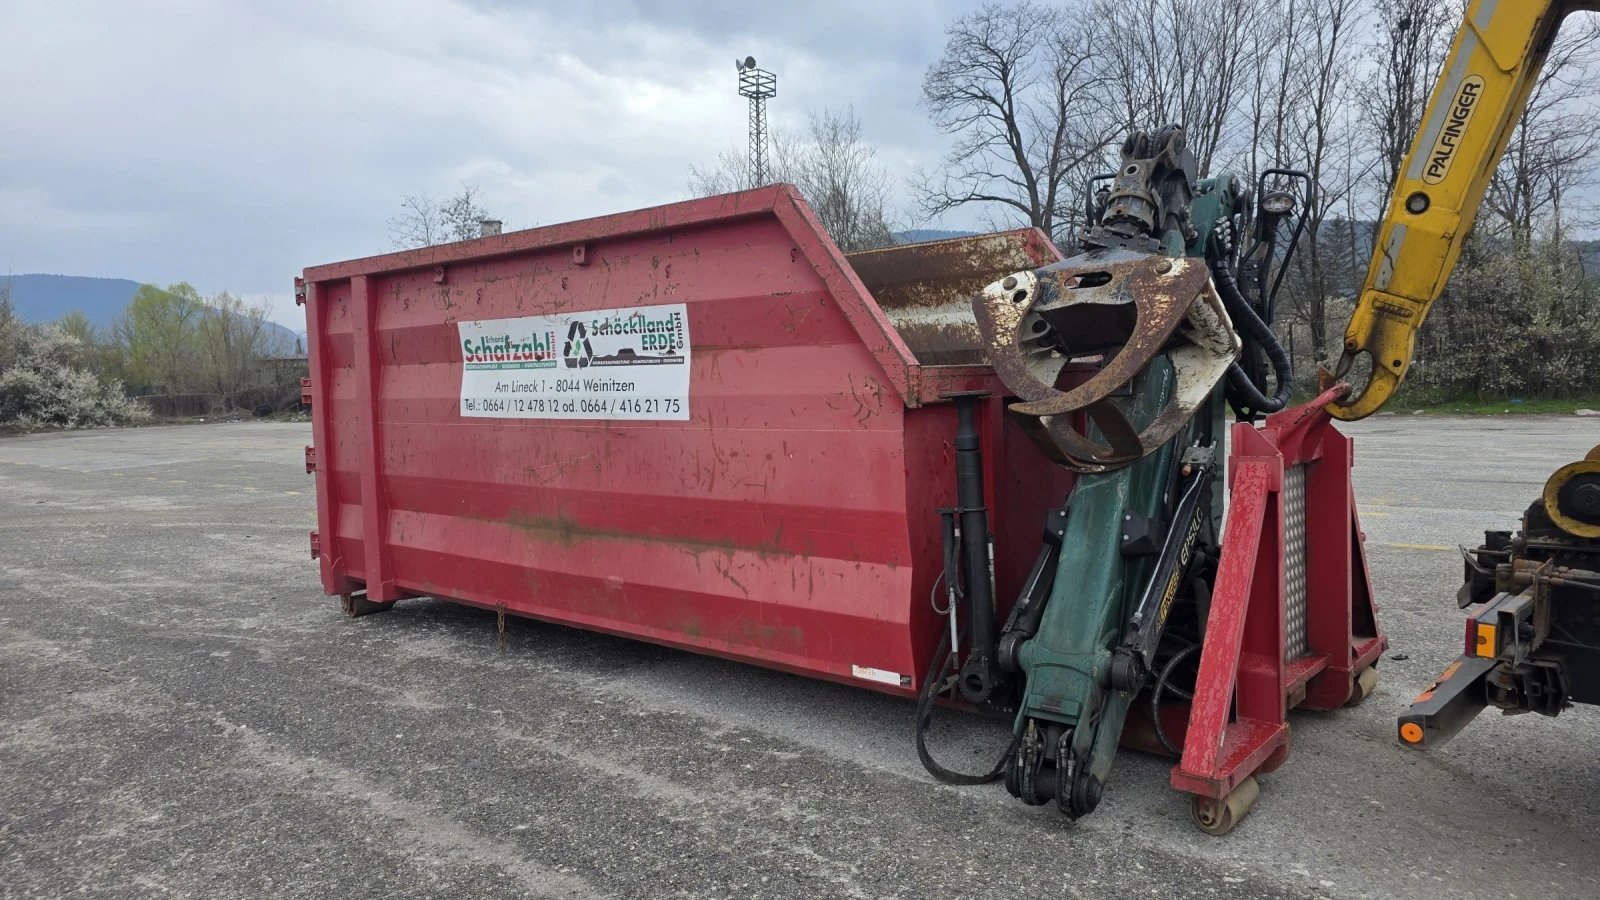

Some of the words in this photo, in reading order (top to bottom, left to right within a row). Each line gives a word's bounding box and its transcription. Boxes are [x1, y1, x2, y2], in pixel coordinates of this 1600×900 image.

[1427, 82, 1481, 178] PALFINGER
[592, 313, 674, 336] Schöcklland
[674, 312, 684, 349] GmbH
[464, 332, 551, 362] Schafzahl
[641, 333, 676, 351] ERDE
[495, 381, 509, 393] Am
[511, 380, 538, 393] Lineck
[556, 379, 580, 392] 8044
[583, 378, 635, 392] Weinitzen
[465, 399, 481, 411] Tel.:
[483, 399, 504, 412] 0664
[514, 399, 524, 412] 12
[527, 399, 544, 412] 478
[548, 400, 559, 412] 12
[562, 398, 578, 413] od.
[580, 399, 607, 413] 0664
[620, 399, 641, 413] 416
[645, 399, 659, 413] 21
[664, 399, 680, 413] 75
